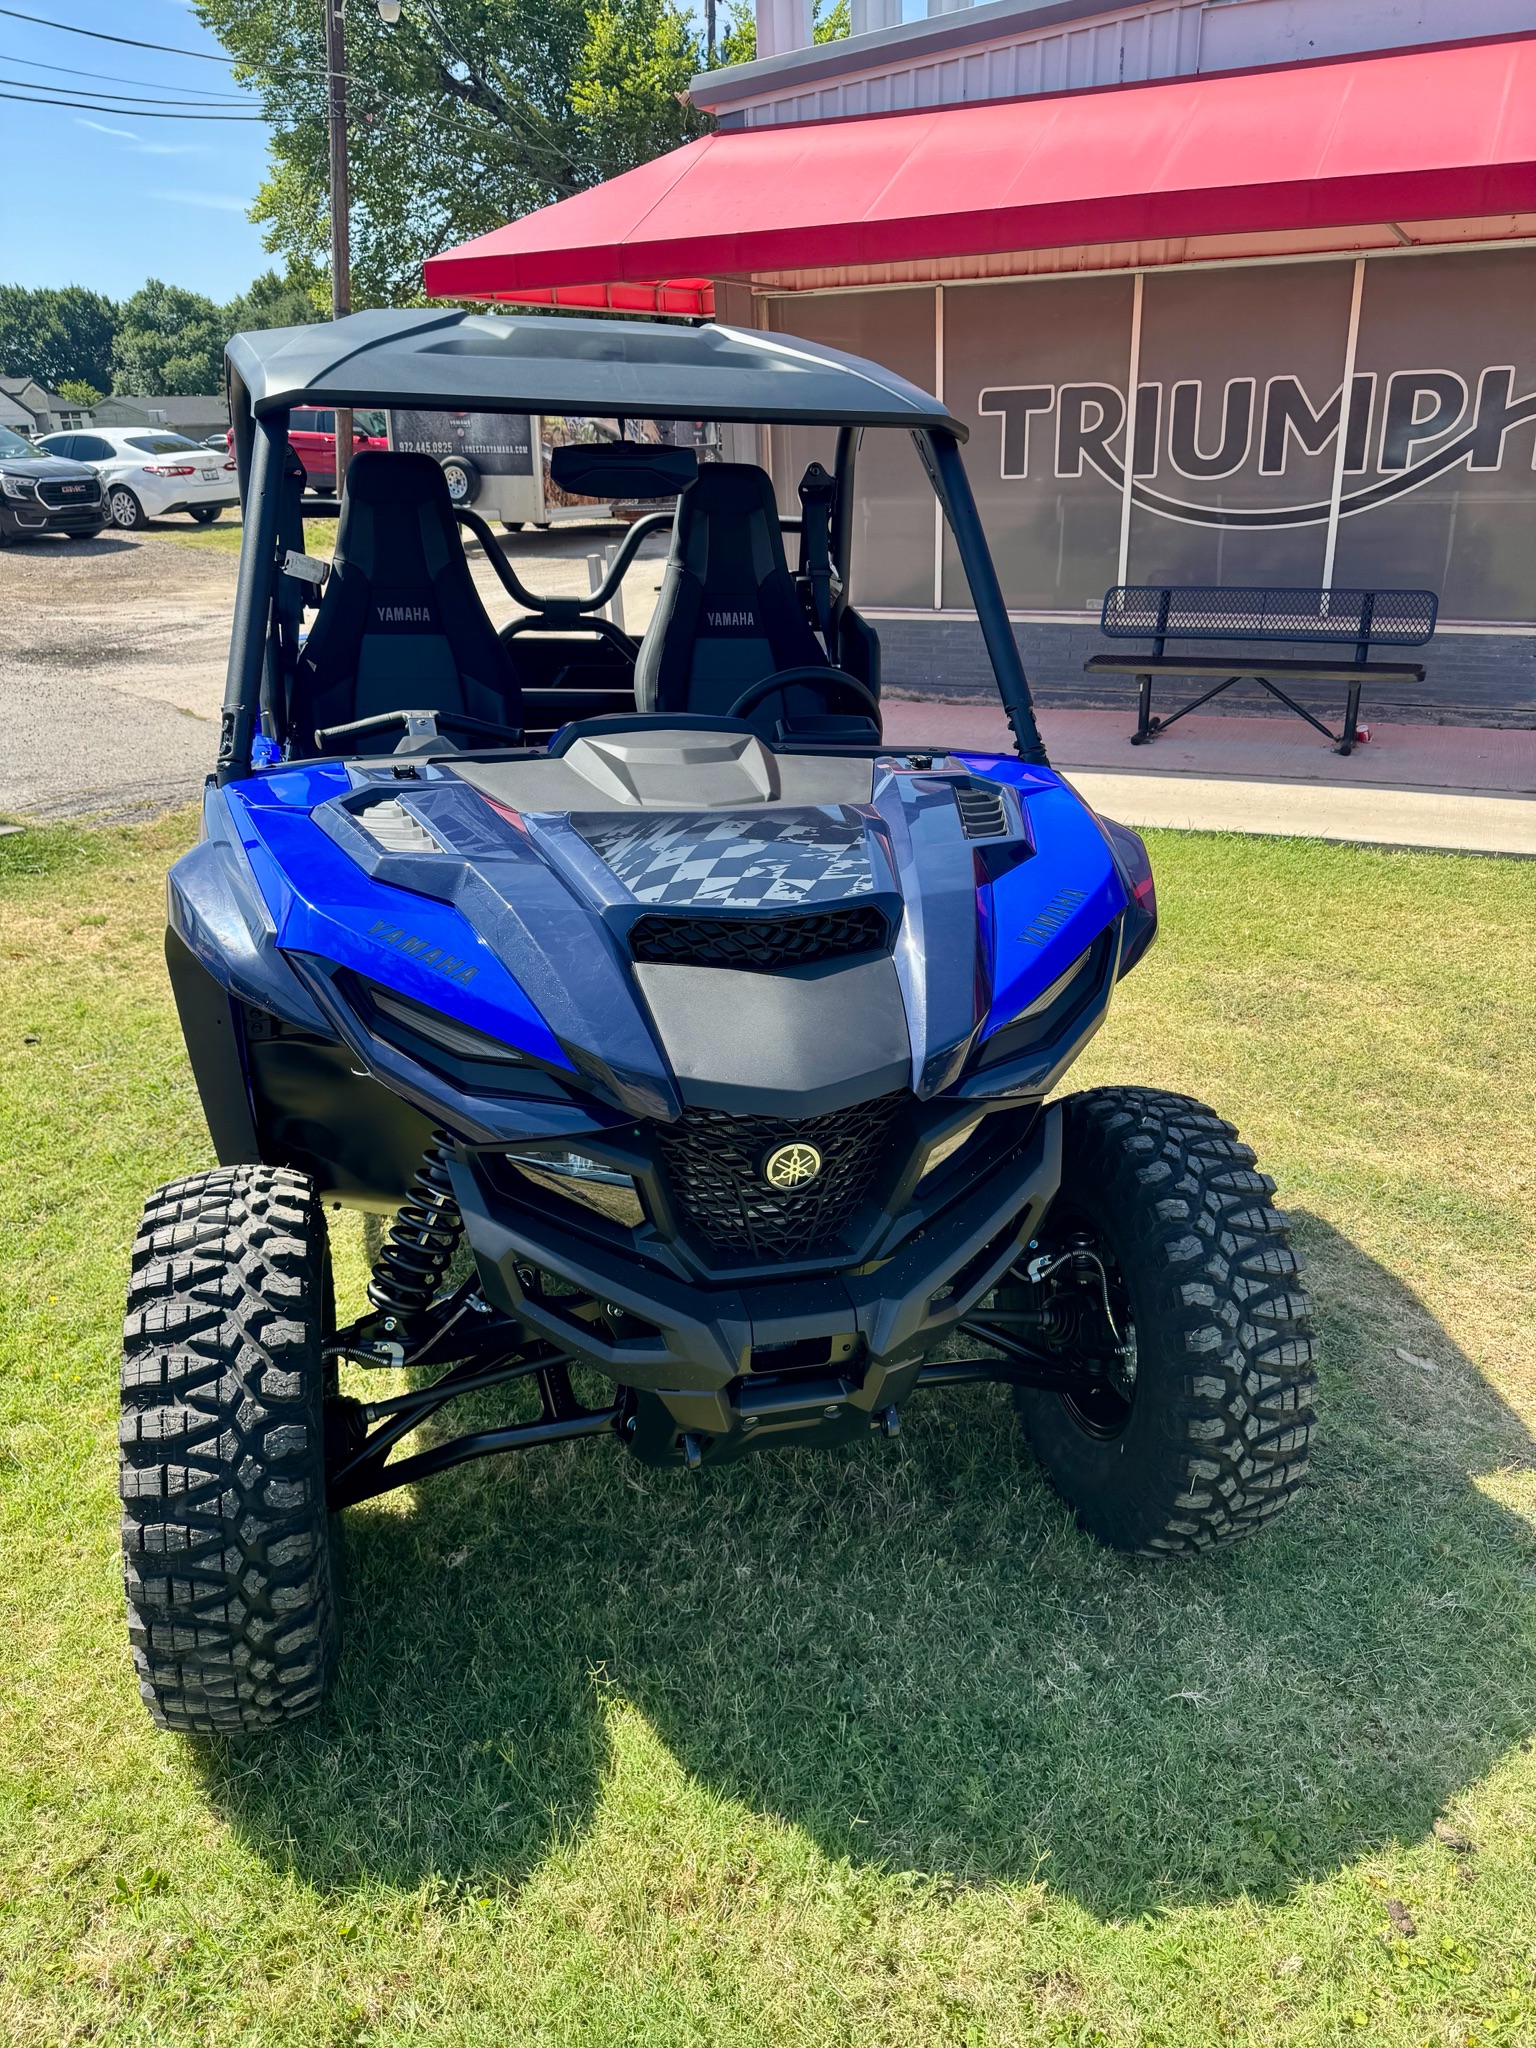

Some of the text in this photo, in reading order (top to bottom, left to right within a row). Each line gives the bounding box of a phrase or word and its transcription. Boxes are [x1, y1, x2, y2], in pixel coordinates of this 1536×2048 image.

[978, 365, 1536, 529] TRIUMPH
[61, 485, 86, 493] GMC
[377, 607, 431, 621] YAMAHA
[707, 612, 755, 626] YAMAHA
[1015, 888, 1090, 948] YAMAHA
[366, 919, 481, 987] YAMAHA
